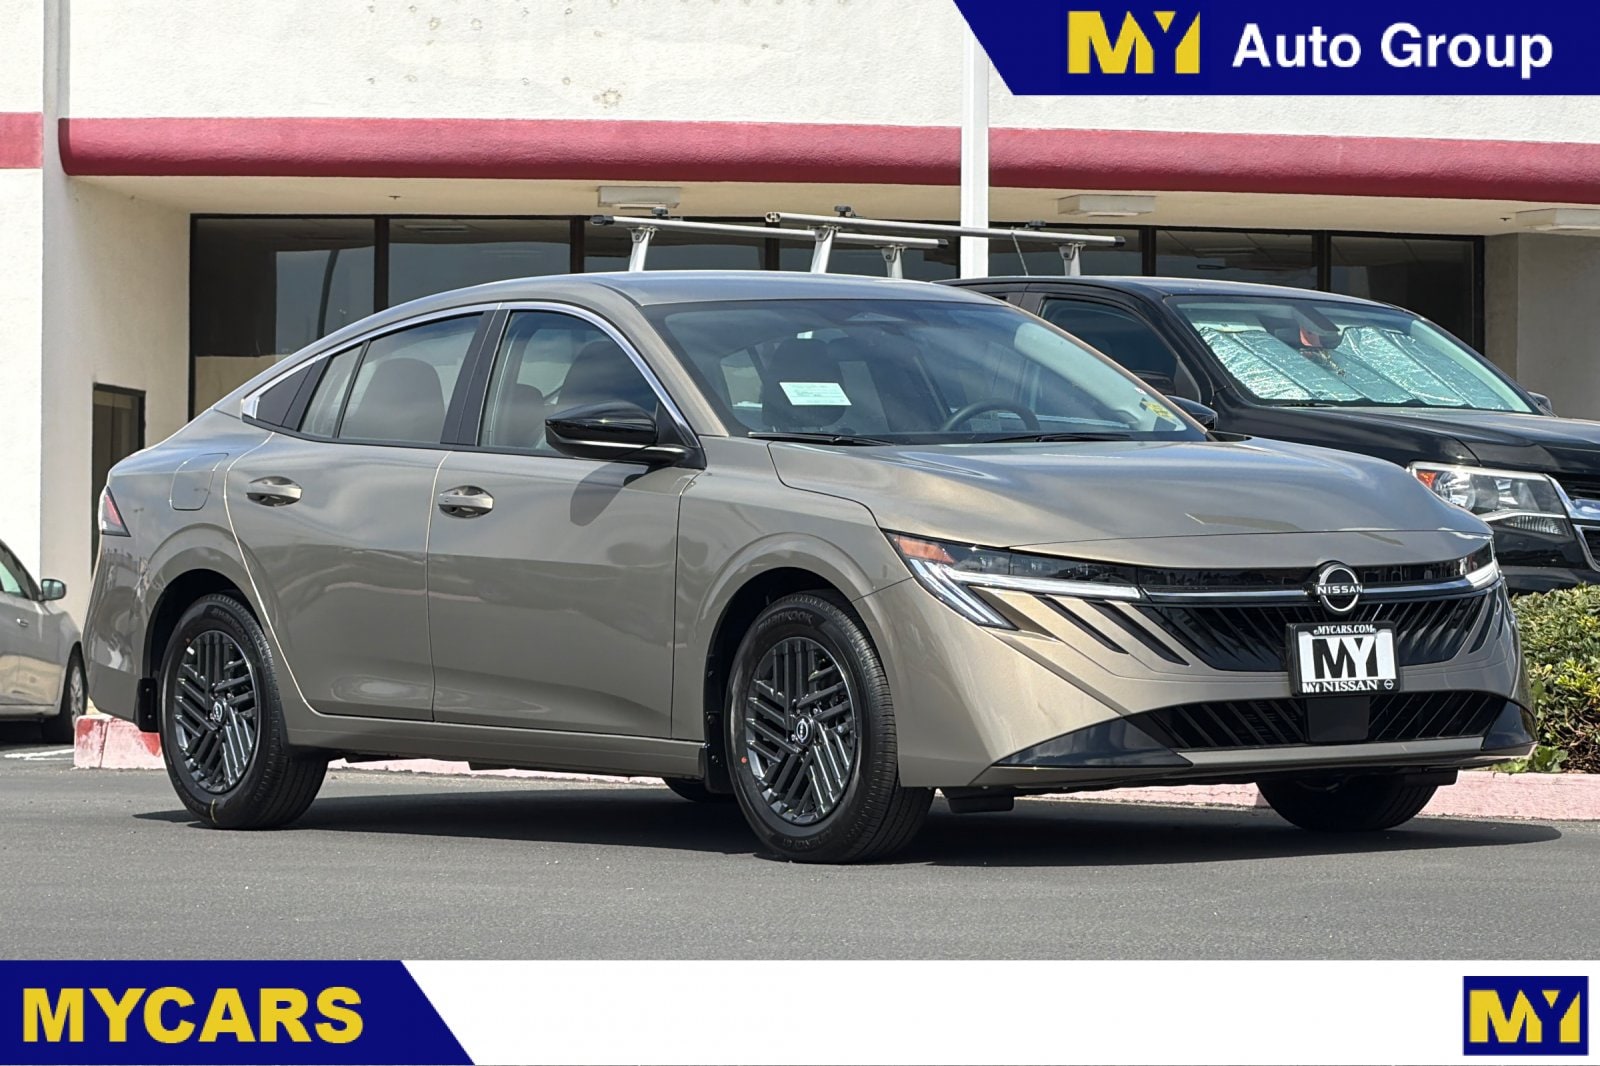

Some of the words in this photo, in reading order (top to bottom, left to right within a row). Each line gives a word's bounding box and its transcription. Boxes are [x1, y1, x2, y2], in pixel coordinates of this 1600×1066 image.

[1317, 584, 1364, 595] NISSAN
[1311, 637, 1379, 679] MY
[1302, 682, 1320, 693] MY
[1322, 679, 1378, 692] NISSAN
